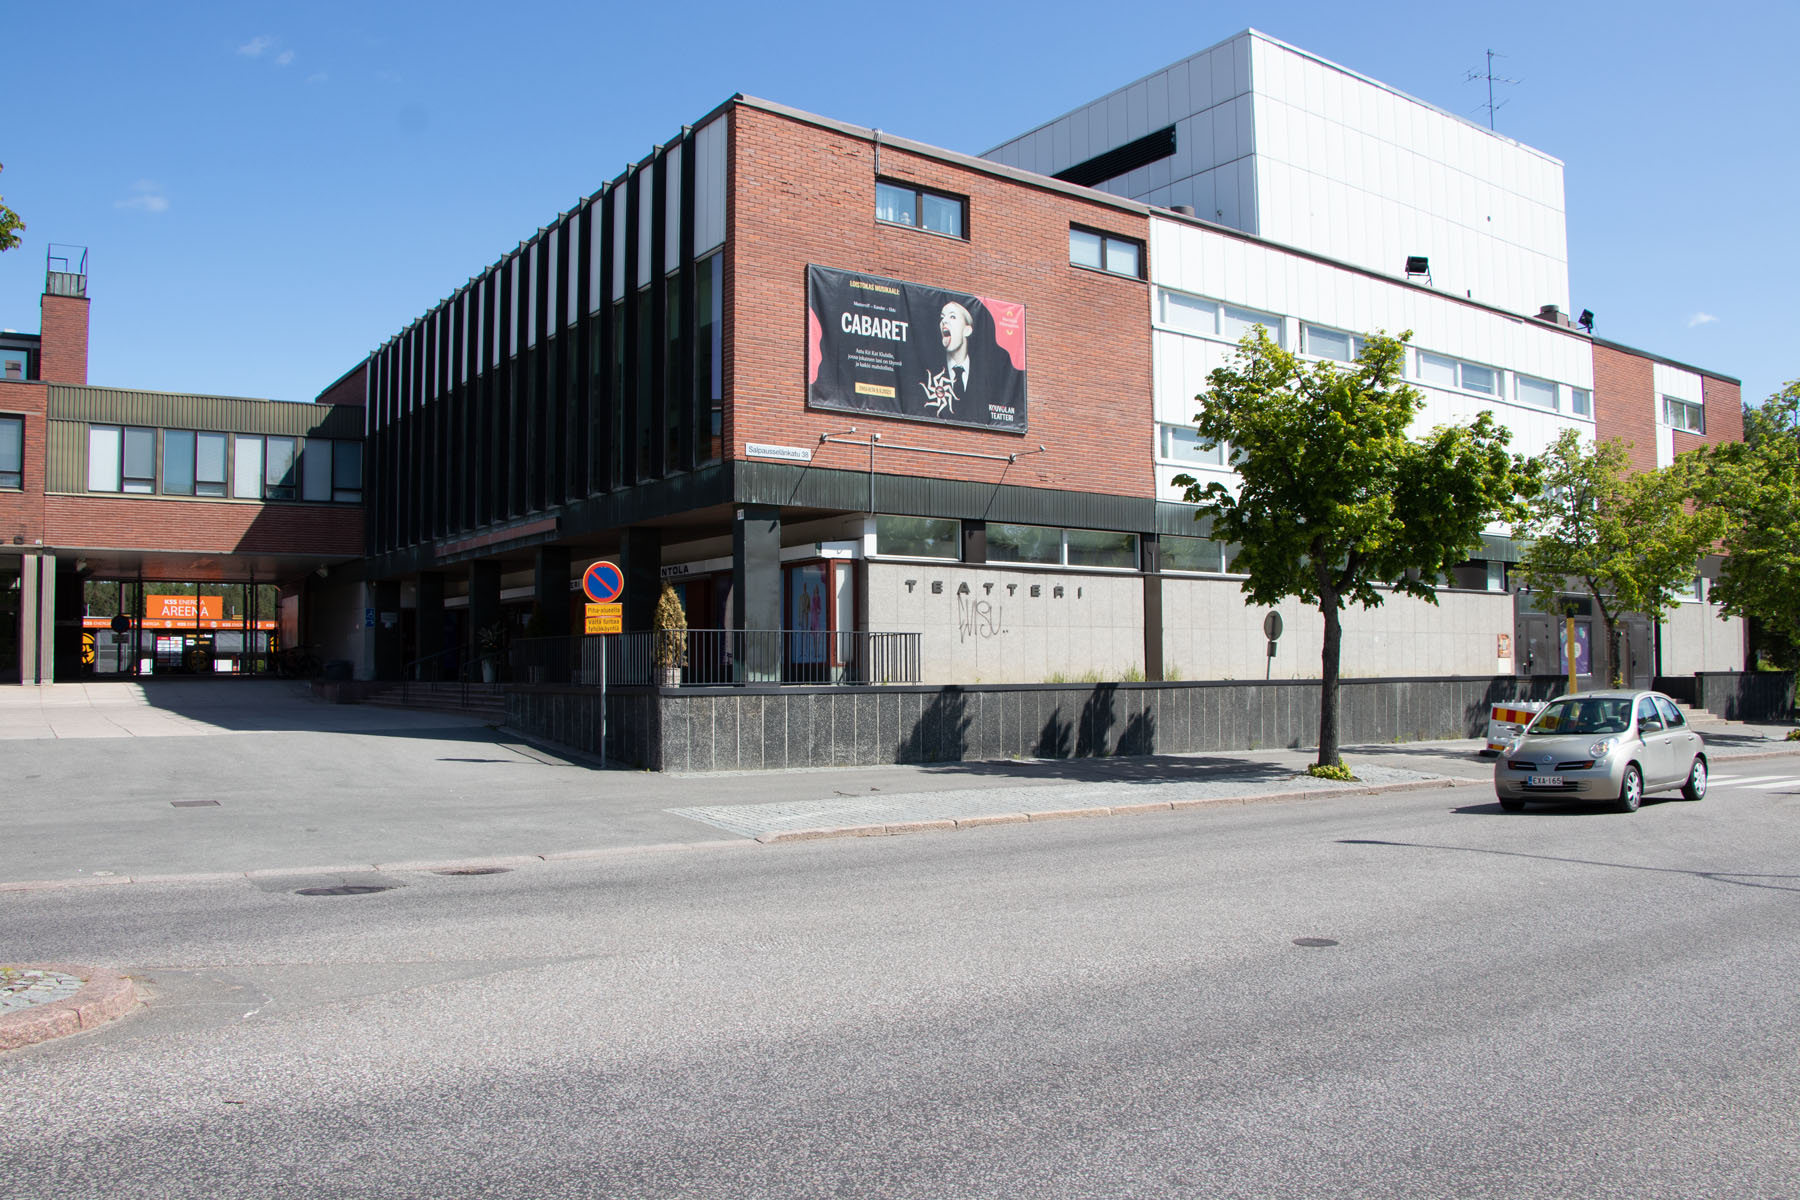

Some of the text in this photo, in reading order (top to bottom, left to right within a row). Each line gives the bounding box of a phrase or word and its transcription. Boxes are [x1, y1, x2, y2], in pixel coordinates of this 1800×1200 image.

[841, 312, 908, 342] CABARET
[988, 403, 1015, 414] KOUVOLAN
[990, 412, 1014, 422] TEATTERI
[748, 445, 801, 458] Salpausselänkatu
[661, 565, 689, 577] NTOLA
[904, 579, 1083, 600] TEATTERI
[161, 605, 209, 617] AREENA
[1533, 777, 1562, 785] EXA-165
